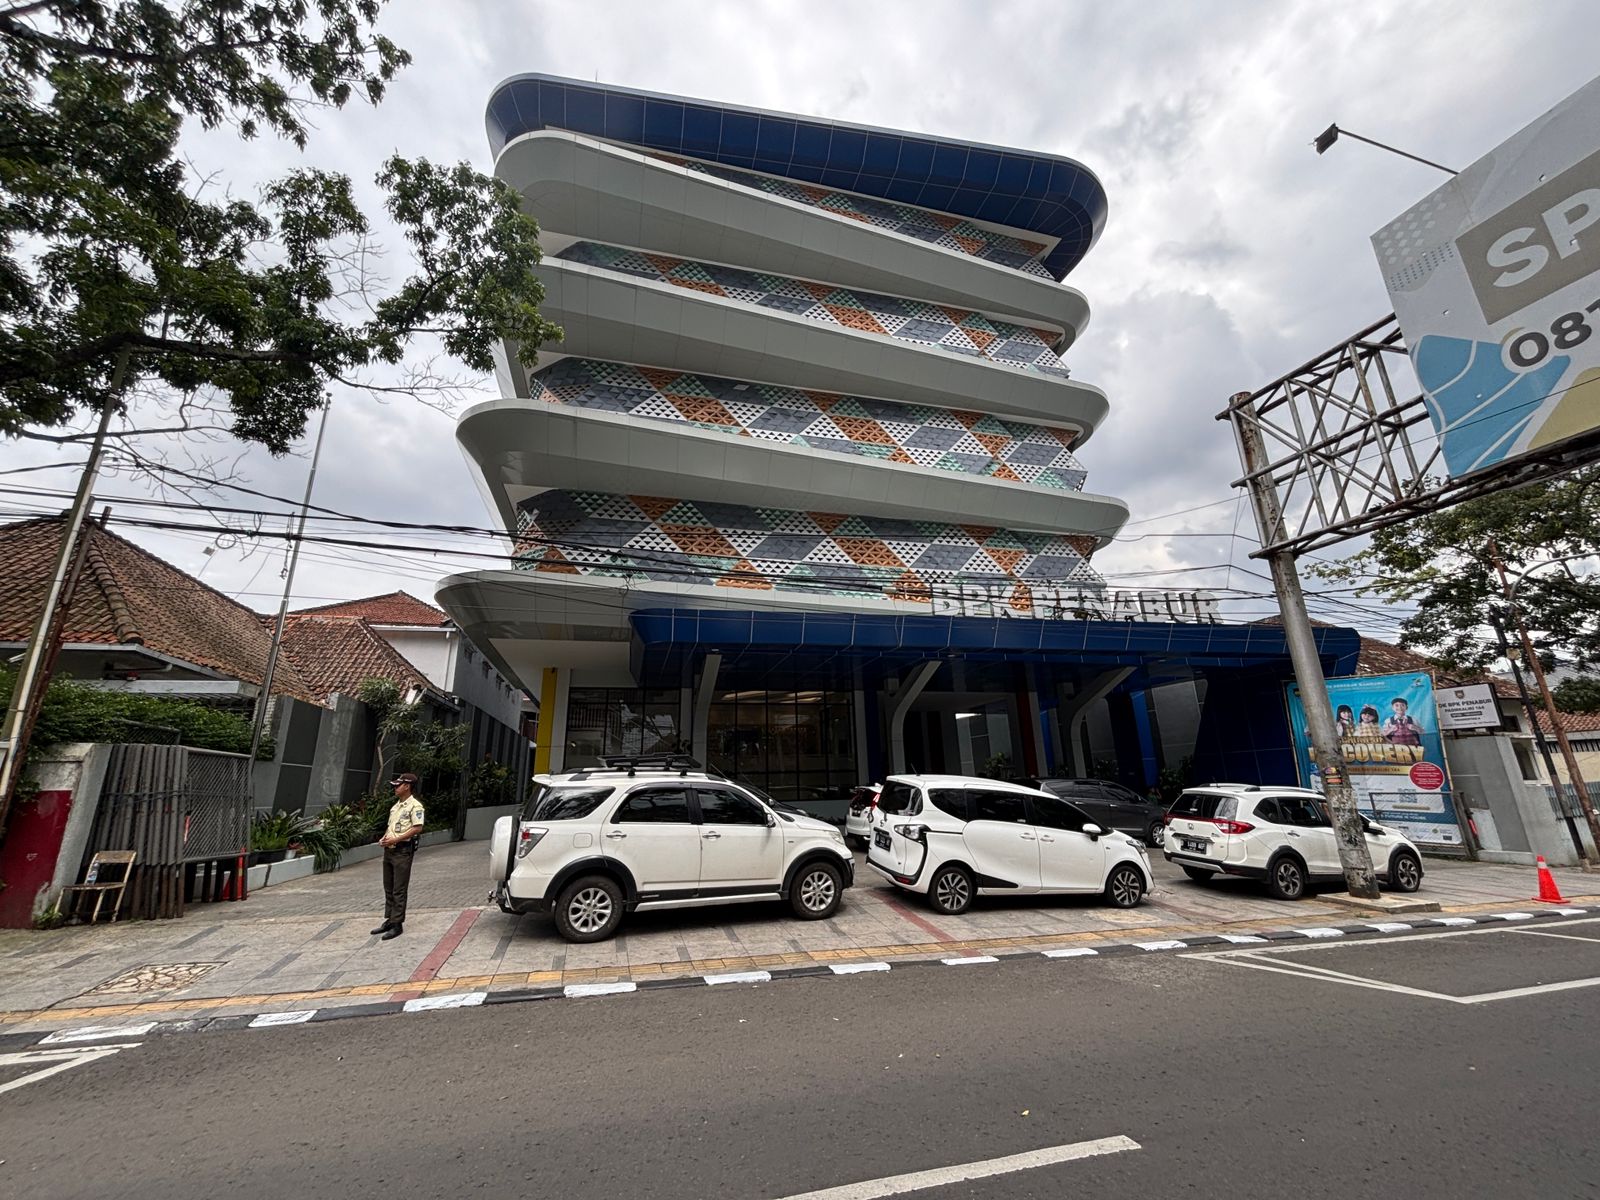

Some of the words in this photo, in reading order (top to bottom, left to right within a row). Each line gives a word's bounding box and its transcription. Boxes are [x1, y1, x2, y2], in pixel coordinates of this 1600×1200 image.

[1487, 188, 1600, 288] SP
[931, 584, 1022, 618] BPK
[1030, 587, 1224, 624] PENABUR
[1462, 698, 1492, 706] PENABUR
